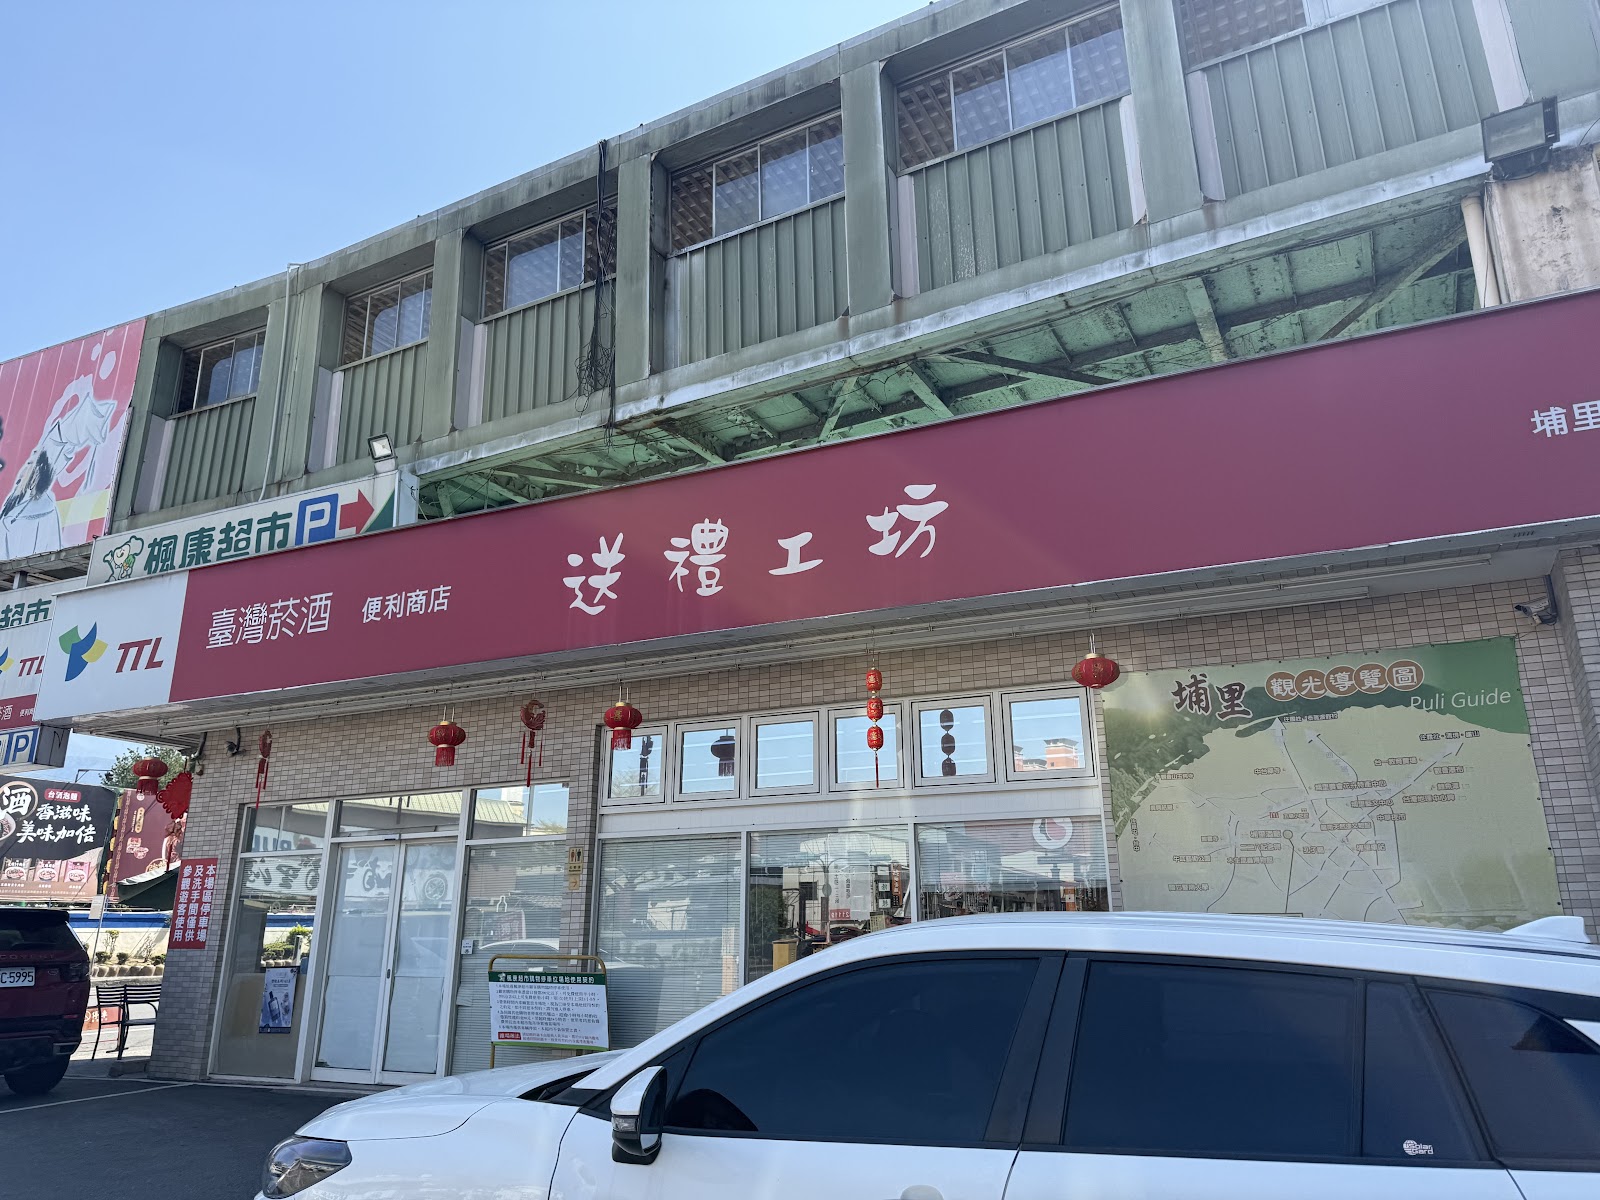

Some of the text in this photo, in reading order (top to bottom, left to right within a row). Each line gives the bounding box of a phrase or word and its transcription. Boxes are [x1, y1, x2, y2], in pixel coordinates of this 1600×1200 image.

[144, 511, 293, 575] 楓康超市
[563, 484, 949, 616] 送禮工坊
[206, 585, 452, 649] 臺灣菸酒 便利商店
[116, 637, 164, 673] TTL
[1171, 666, 1419, 720] 埔里 觀光導覽圖
[1410, 687, 1512, 710] Puli Guide
[16, 820, 96, 844] 美味加倍
[36, 803, 92, 822] 香滋味
[185, 865, 204, 942] 及洗手間僅供
[196, 864, 217, 942] 本場區停車場
